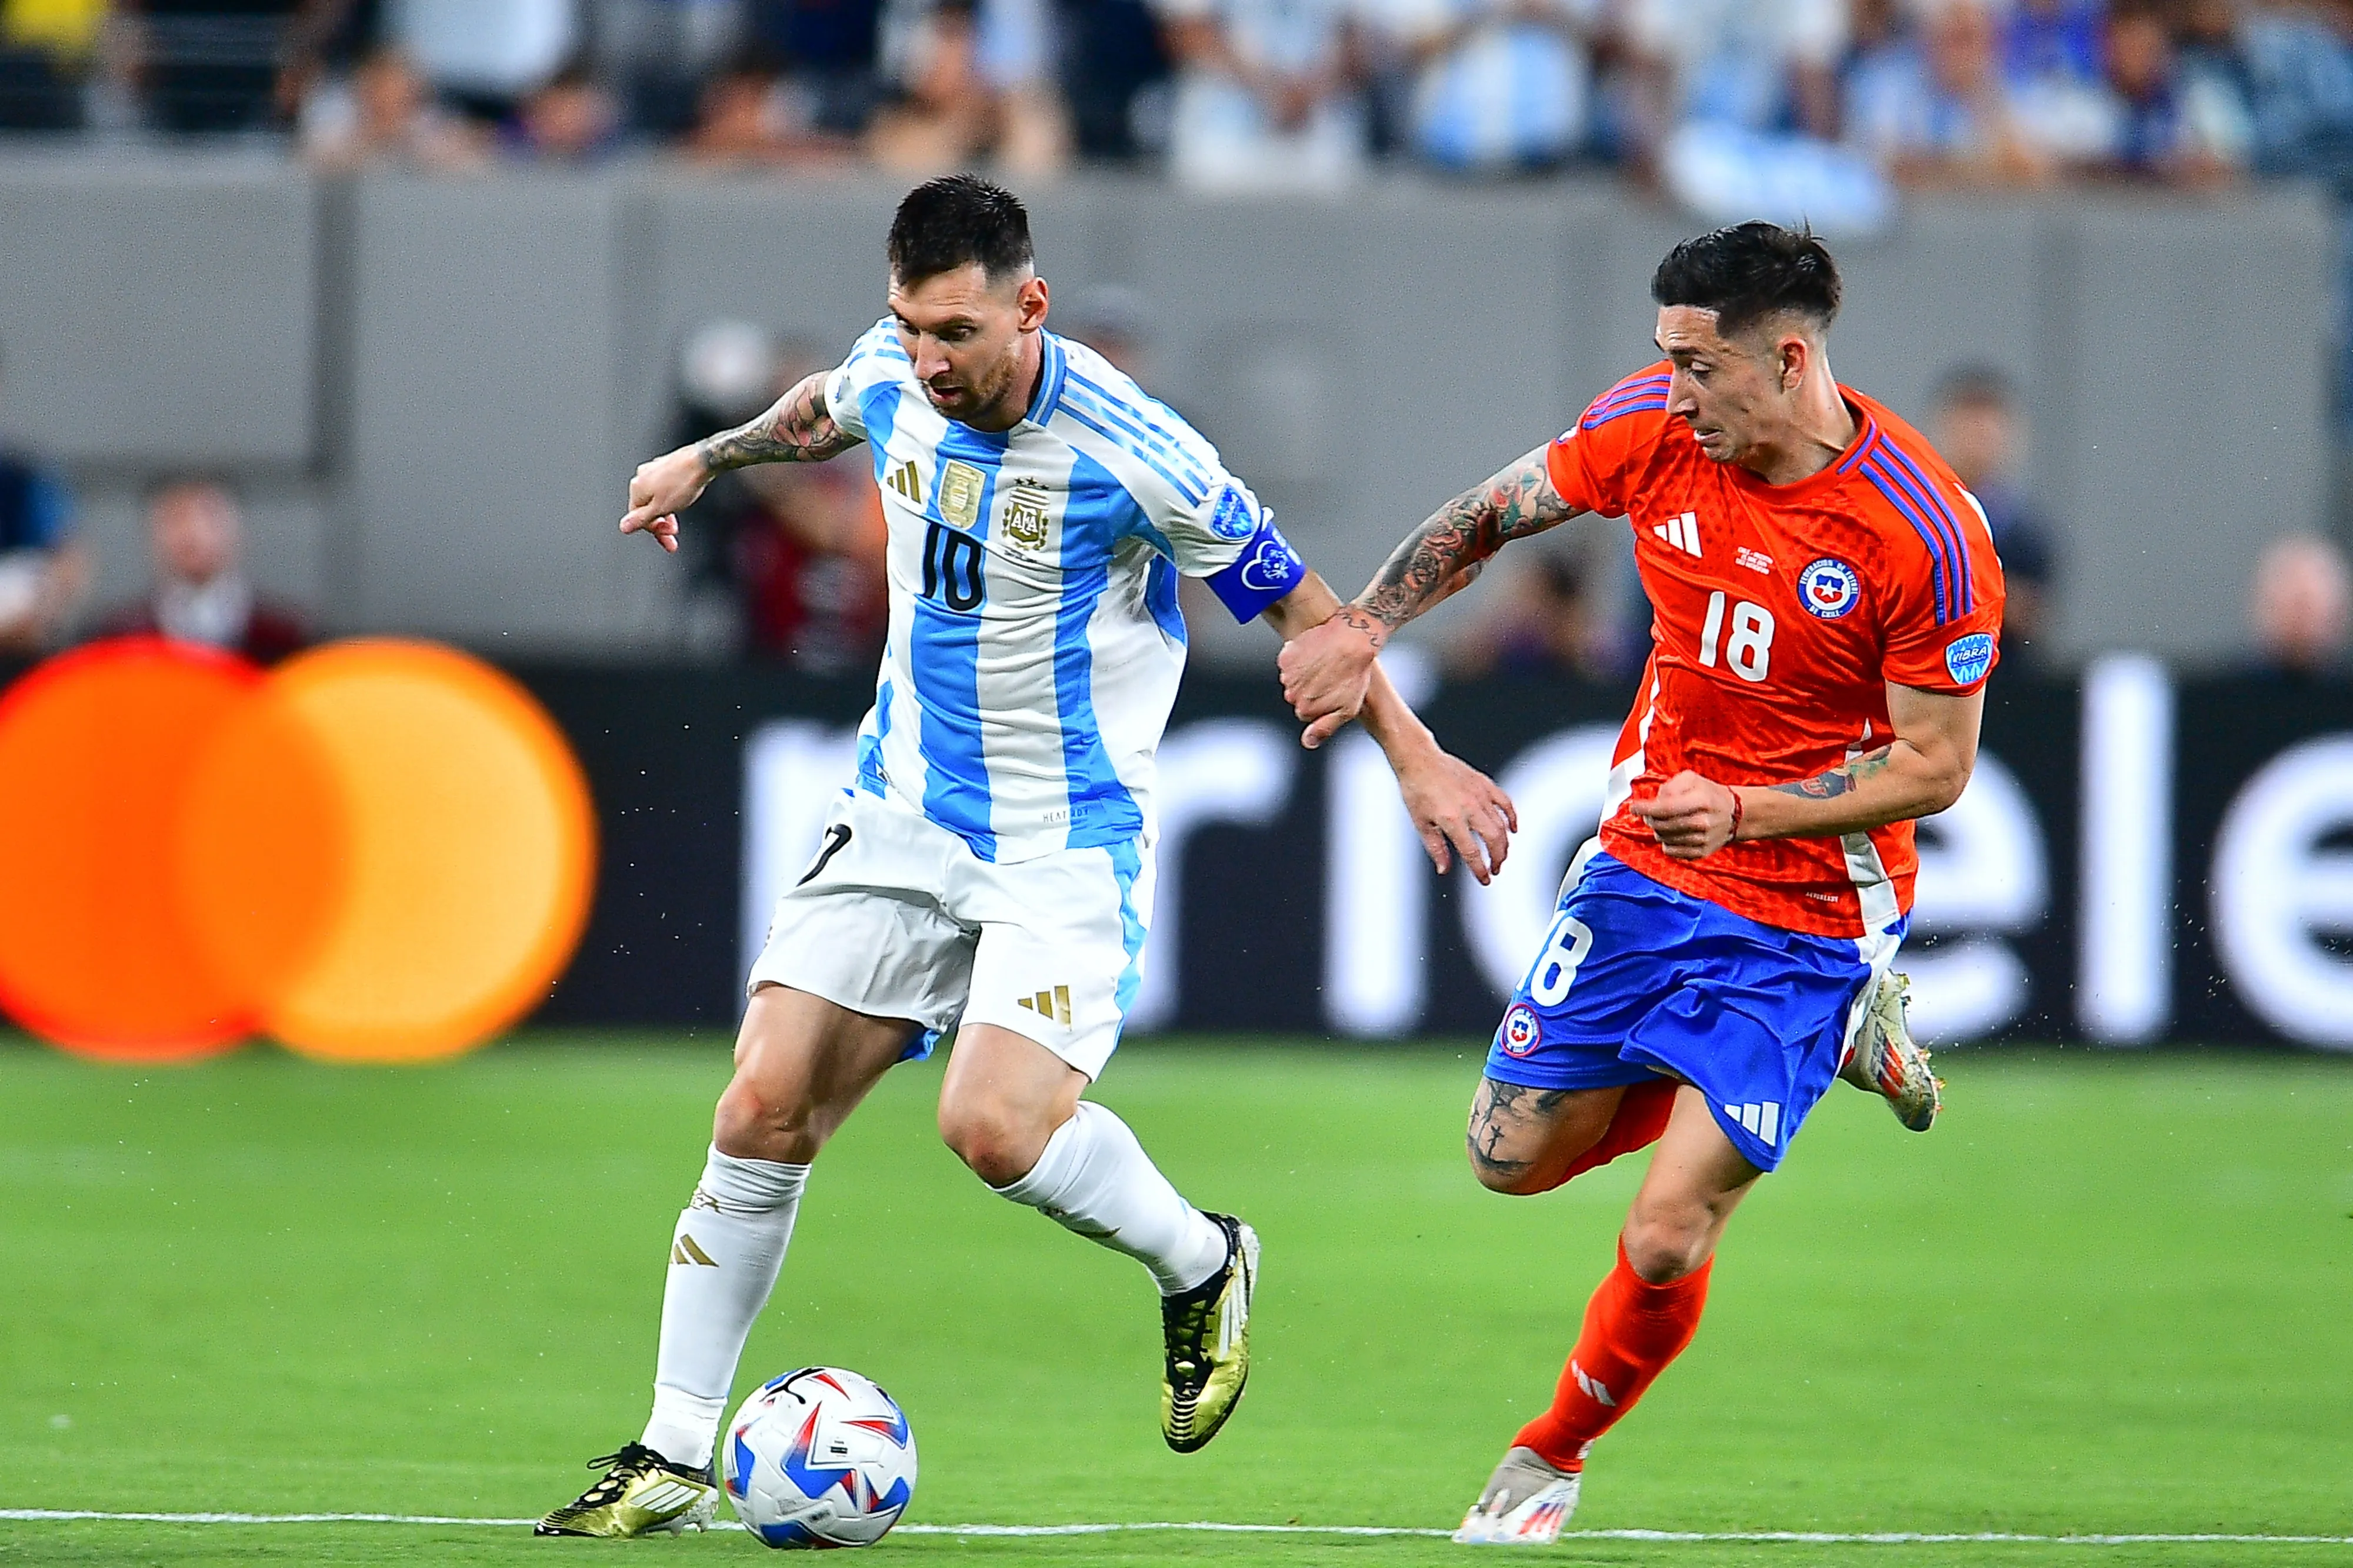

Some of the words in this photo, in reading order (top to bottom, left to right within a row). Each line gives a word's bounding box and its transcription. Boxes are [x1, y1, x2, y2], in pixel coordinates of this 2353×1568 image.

[1011, 505, 1038, 536] AFA
[922, 521, 984, 612] 10
[1698, 590, 1775, 682] 18
